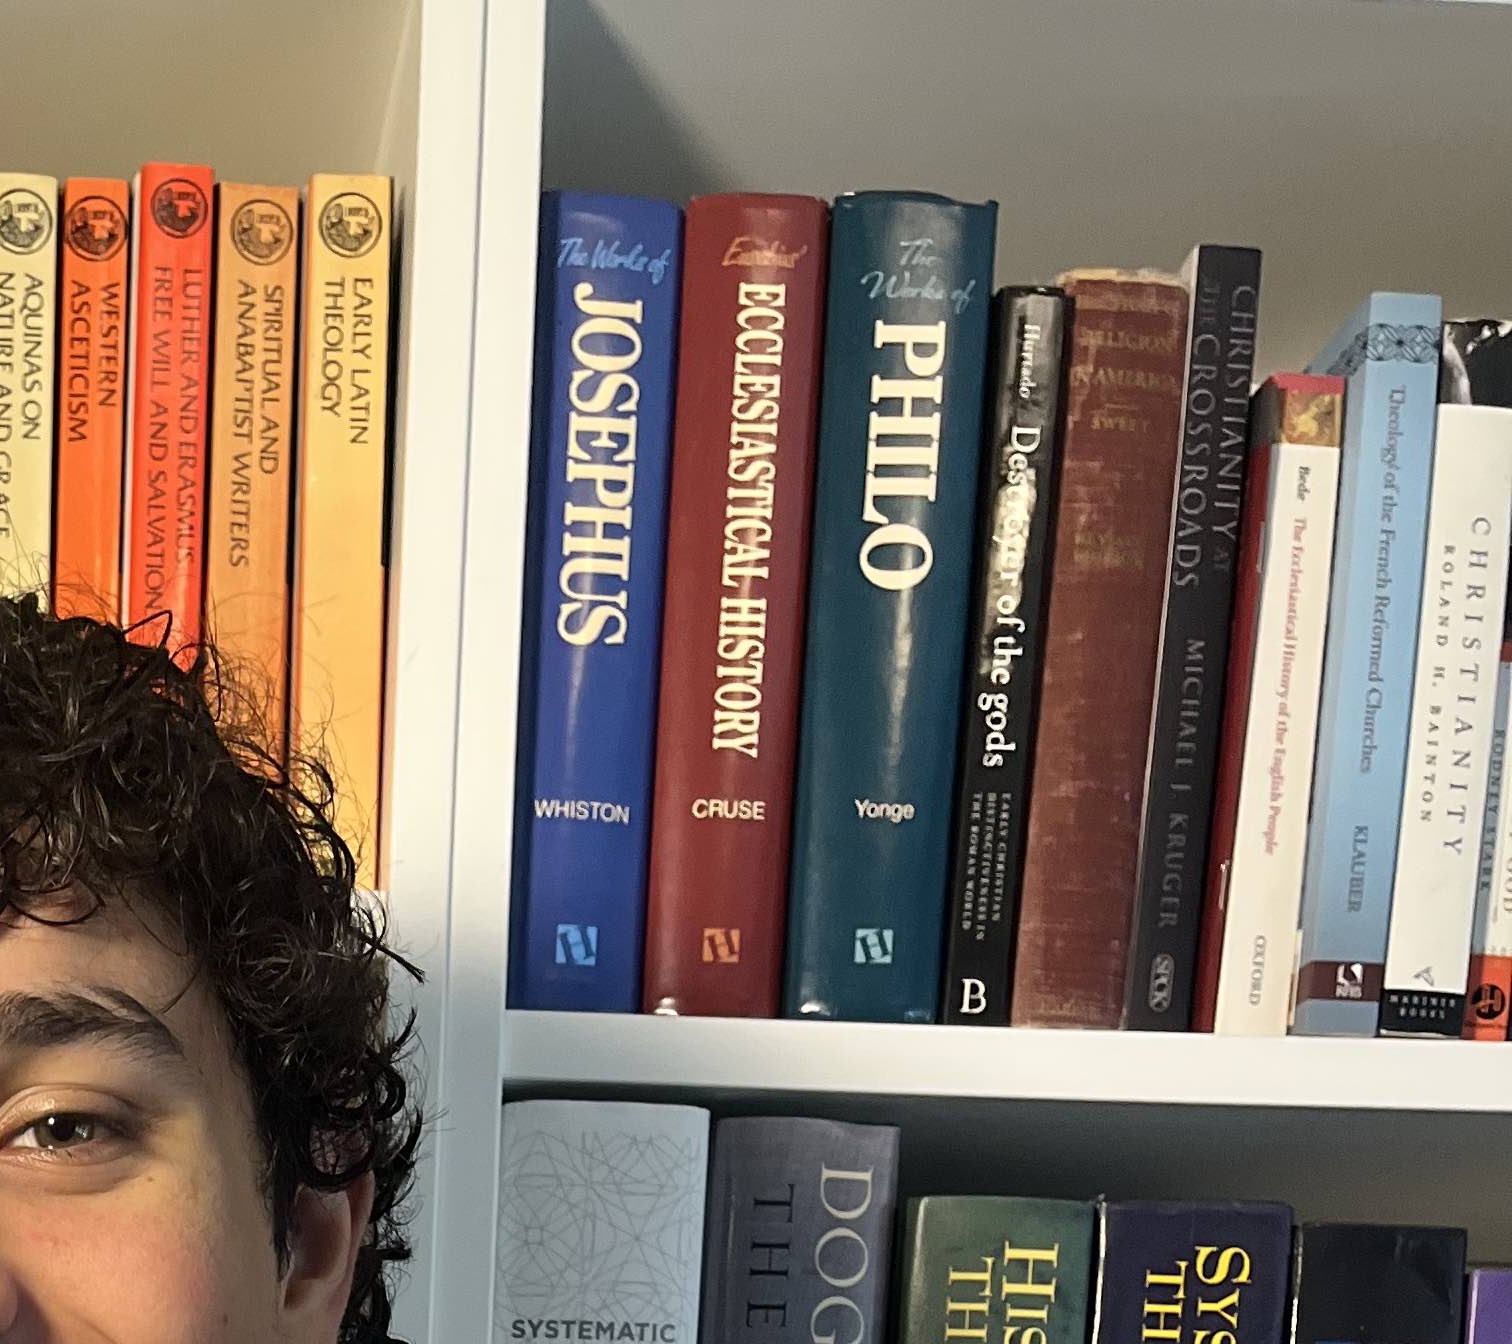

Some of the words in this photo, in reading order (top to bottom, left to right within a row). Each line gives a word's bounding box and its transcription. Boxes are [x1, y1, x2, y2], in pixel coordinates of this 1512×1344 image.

[68, 280, 90, 443] ASCETICISM
[98, 282, 119, 408] WESTERN
[234, 279, 256, 443] ANABAPTIST
[263, 285, 283, 410] SPIRITUAL
[322, 277, 344, 417] THEOLOGY
[352, 277, 373, 360] EARLY
[260, 415, 280, 474] AND
[350, 369, 370, 445] LATIN
[720, 282, 787, 588] ECCLESIASTICAL
[1212, 286, 1257, 540] CHRISTIANITY
[1381, 385, 1407, 467] Theology
[555, 282, 643, 646] JOSEPHUS
[860, 320, 947, 590] PHILO
[1173, 332, 1220, 588] CROSSROADS
[1382, 472, 1397, 493] of
[230, 452, 252, 568] WRITERS
[1378, 497, 1397, 523] the
[1374, 528, 1396, 589] French
[1435, 544, 1456, 648] ROLAND
[997, 594, 1024, 630] of
[1366, 595, 1391, 683] Reformed
[710, 596, 768, 758] HISTORY
[990, 636, 1022, 685] the
[1442, 516, 1492, 856] CHRISTIANITY
[979, 692, 1017, 768] gods
[1359, 688, 1382, 773] Churches
[1420, 705, 1442, 823] BAINTON
[534, 800, 630, 823] WHISTON
[692, 799, 766, 819] CRUSE
[854, 799, 915, 820] Yonge
[1347, 825, 1369, 914] KLAUBER
[1248, 935, 1267, 1006] OXFORD
[510, 1319, 676, 1344] SYSTEMATIC
